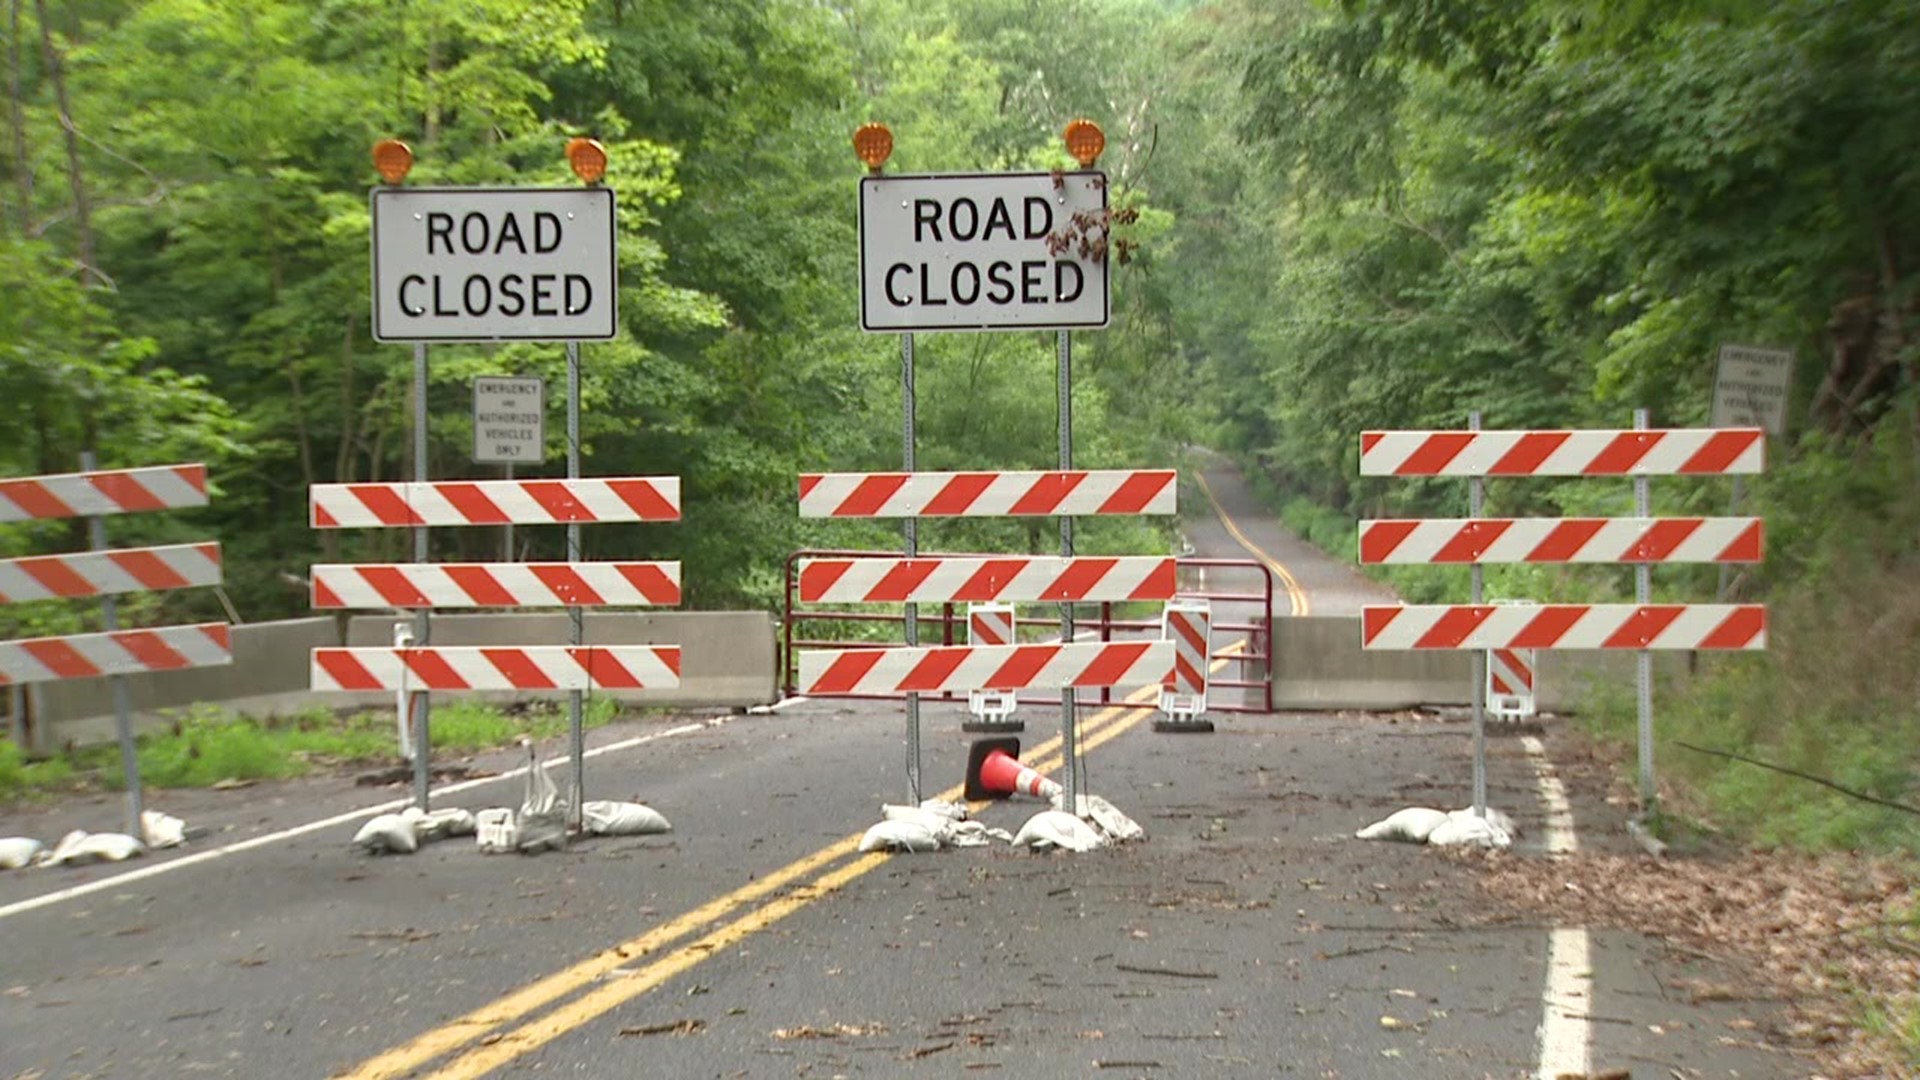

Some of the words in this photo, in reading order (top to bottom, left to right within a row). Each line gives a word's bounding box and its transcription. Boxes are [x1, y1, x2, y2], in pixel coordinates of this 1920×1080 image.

[427, 211, 563, 255] ROAD
[913, 196, 1053, 243] ROAD
[398, 273, 593, 318] CLOSED
[884, 259, 1084, 307] CLOSED
[479, 383, 537, 394] EMERGENCY
[479, 413, 539, 424] AUTHORIZED
[485, 429, 533, 440] VEHICLES
[495, 445, 521, 456] ONLY
